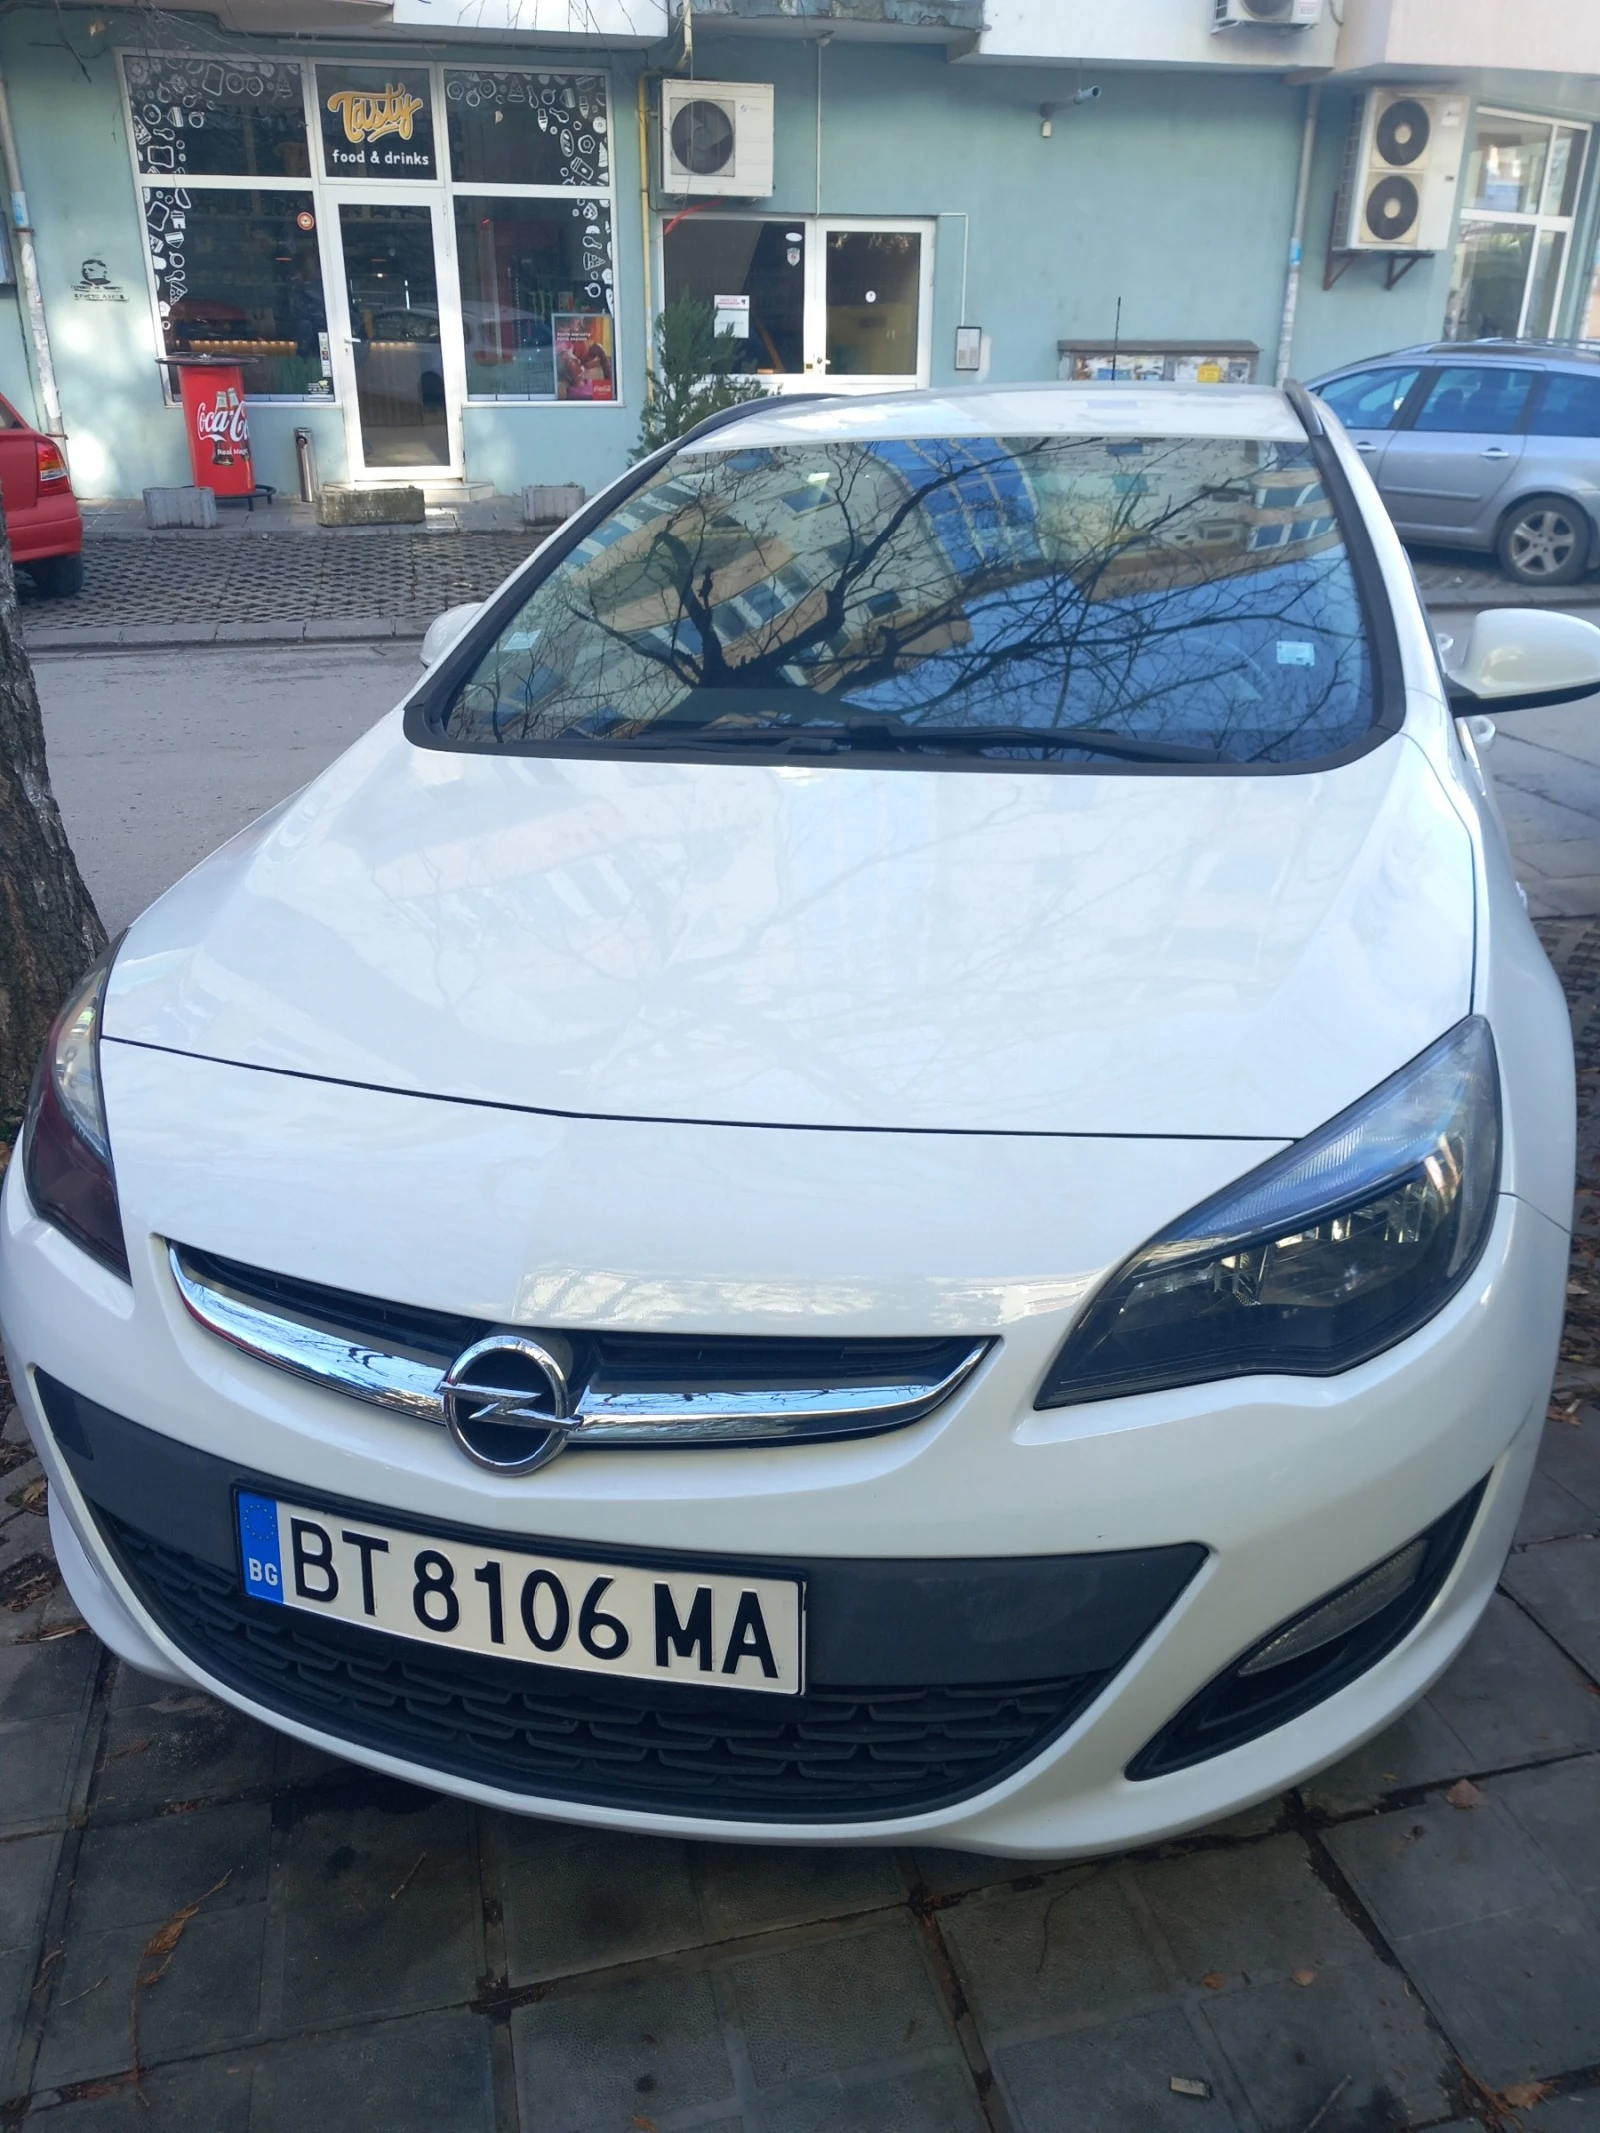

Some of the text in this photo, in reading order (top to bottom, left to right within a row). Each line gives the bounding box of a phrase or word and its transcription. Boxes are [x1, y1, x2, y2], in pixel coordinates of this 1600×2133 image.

[327, 82, 424, 143] Tasty
[332, 149, 429, 165] food & drinks
[248, 1557, 279, 1586] BG
[290, 1516, 780, 1679] BT 8106 MA
